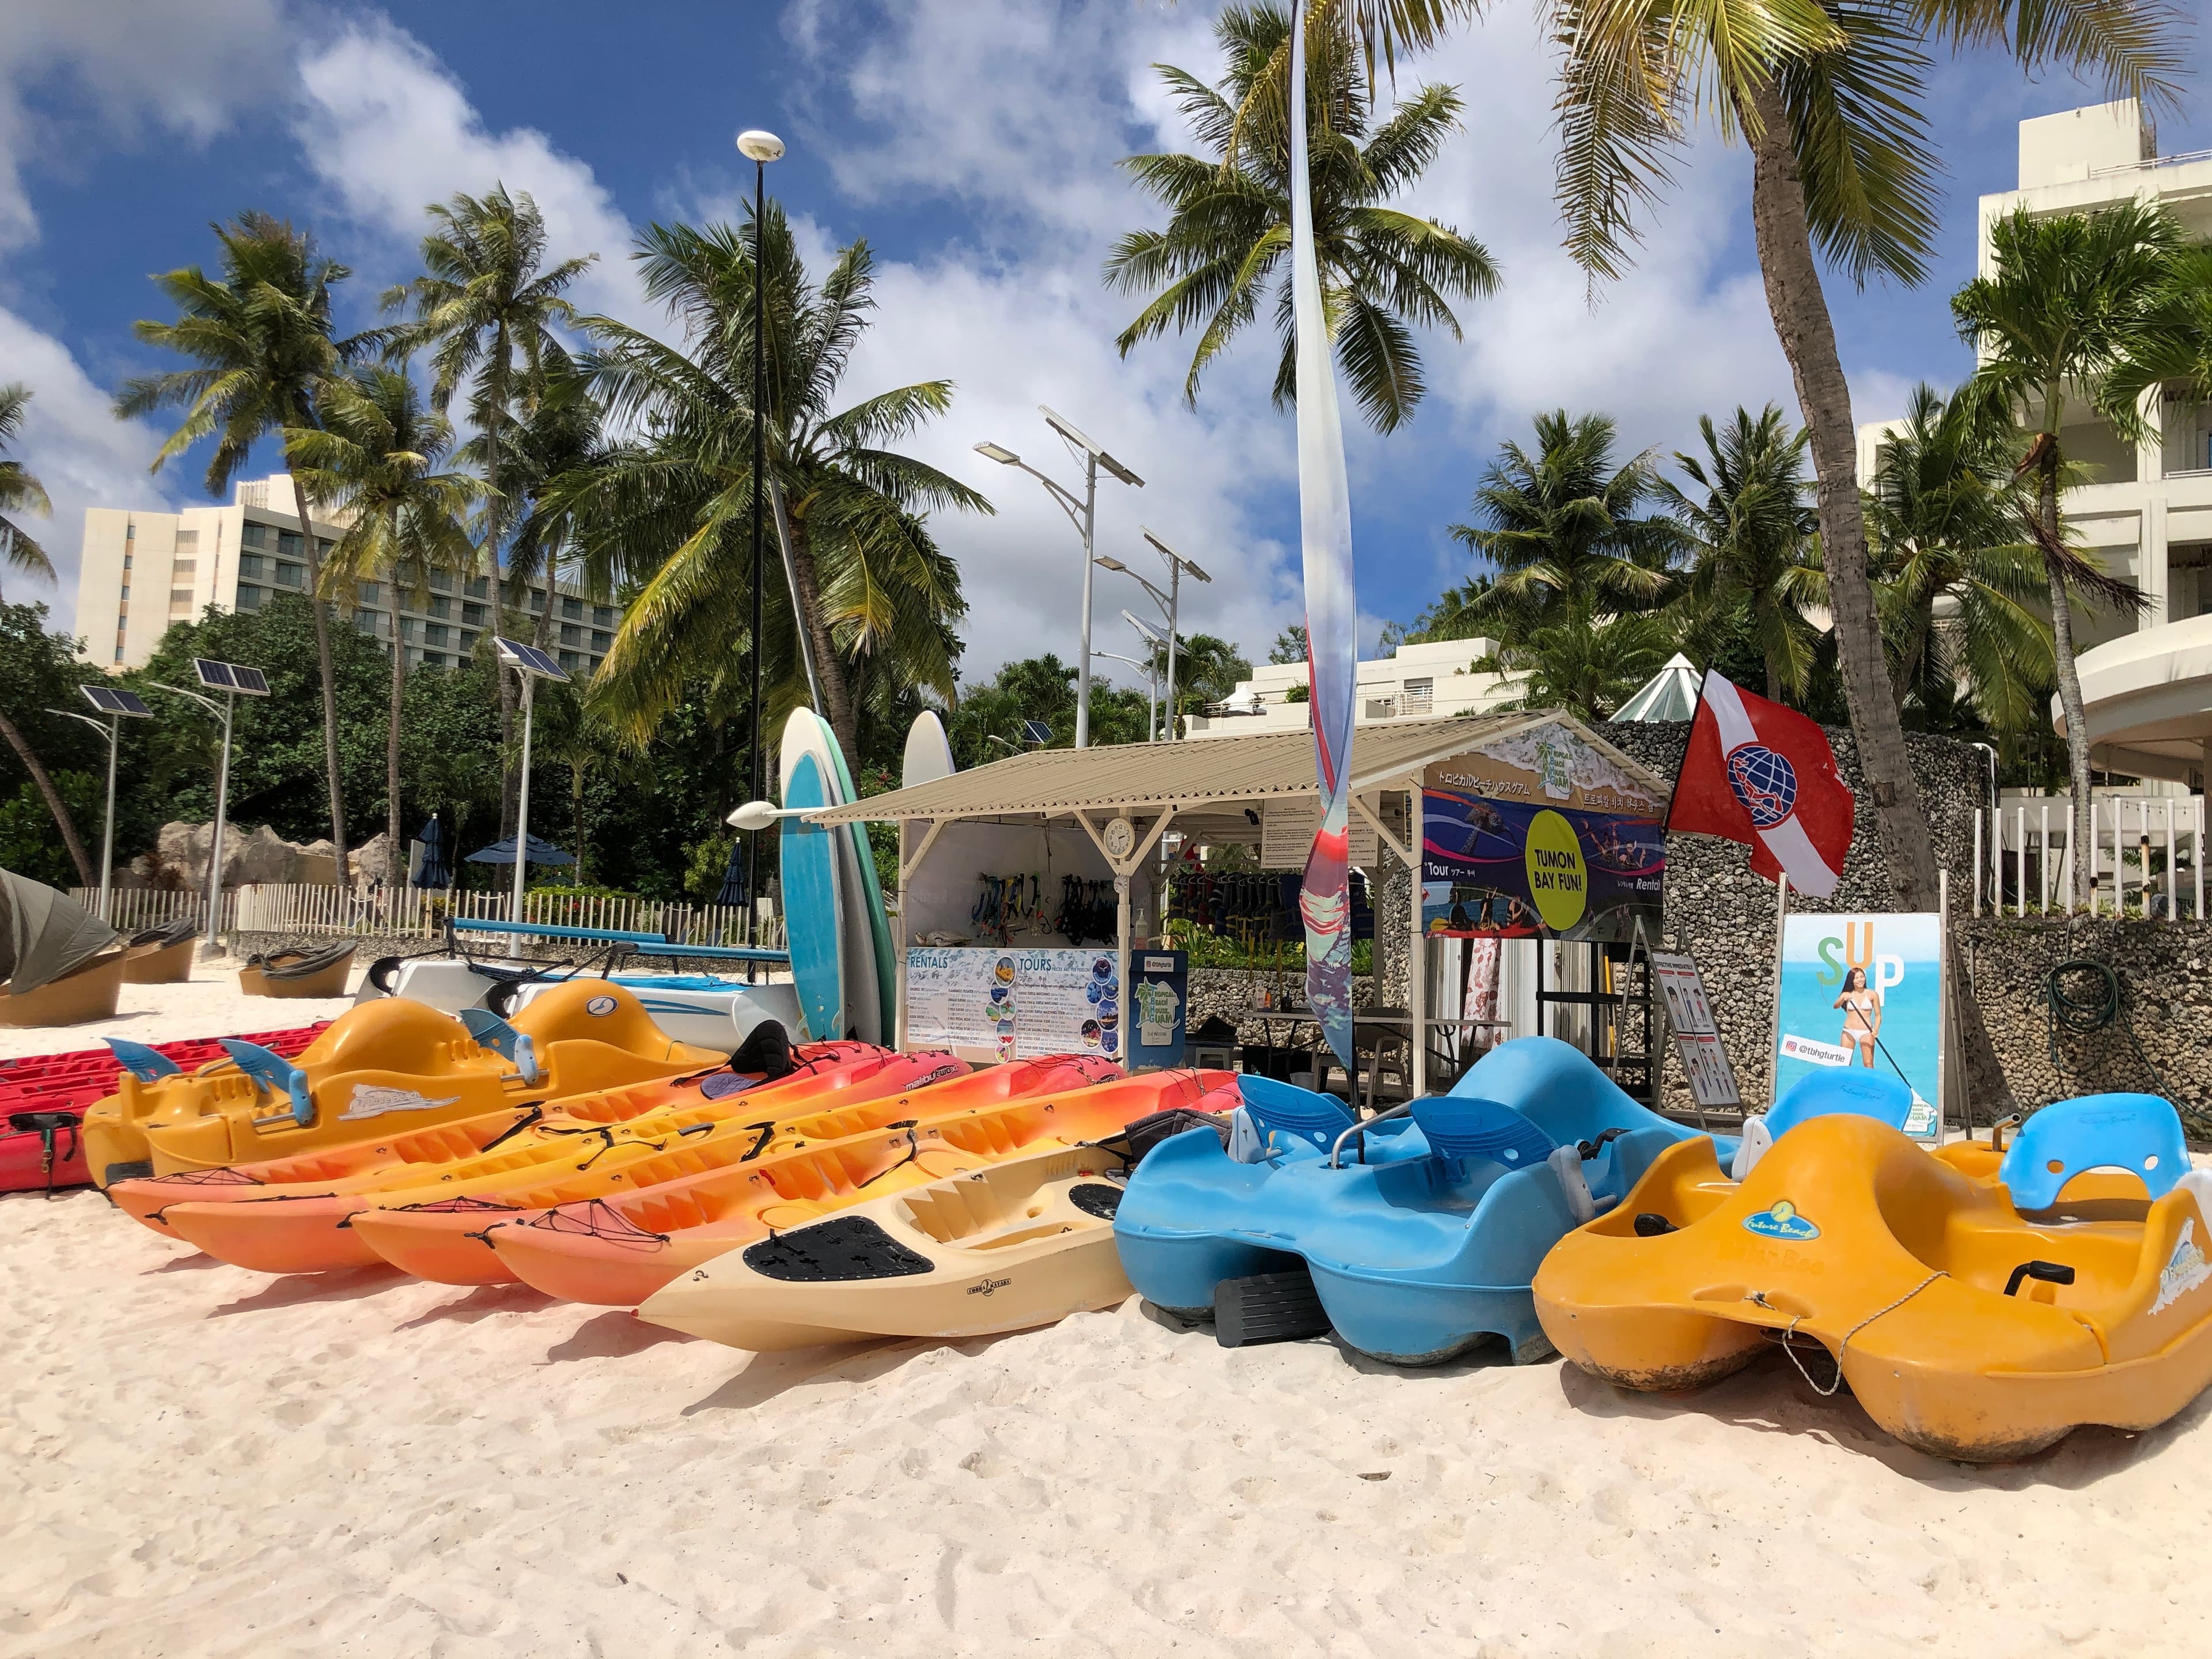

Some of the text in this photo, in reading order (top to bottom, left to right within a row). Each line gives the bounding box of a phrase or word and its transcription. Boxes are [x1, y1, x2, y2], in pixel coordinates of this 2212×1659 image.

[1550, 775, 1569, 789] GUAM
[1534, 849, 1576, 870] TUMON
[1427, 861, 1449, 876] Tour
[1450, 868, 1465, 876] ツアー
[1533, 870, 1582, 892] BAY FUN!
[1636, 878, 1661, 891] Rental
[910, 956, 948, 969] RENTALS
[1019, 958, 1052, 971] TOURS
[1816, 921, 1904, 1007] SUP
[1148, 986, 1176, 998] TROPICAL
[1150, 997, 1168, 1006] BEACH
[1149, 1014, 1173, 1024] GUAM
[1799, 1045, 1845, 1063] @tbhgturtle
[392, 1091, 421, 1103] Beach
[1779, 1222, 1813, 1238] Beach
[990, 1279, 1010, 1288] KAYAKS
